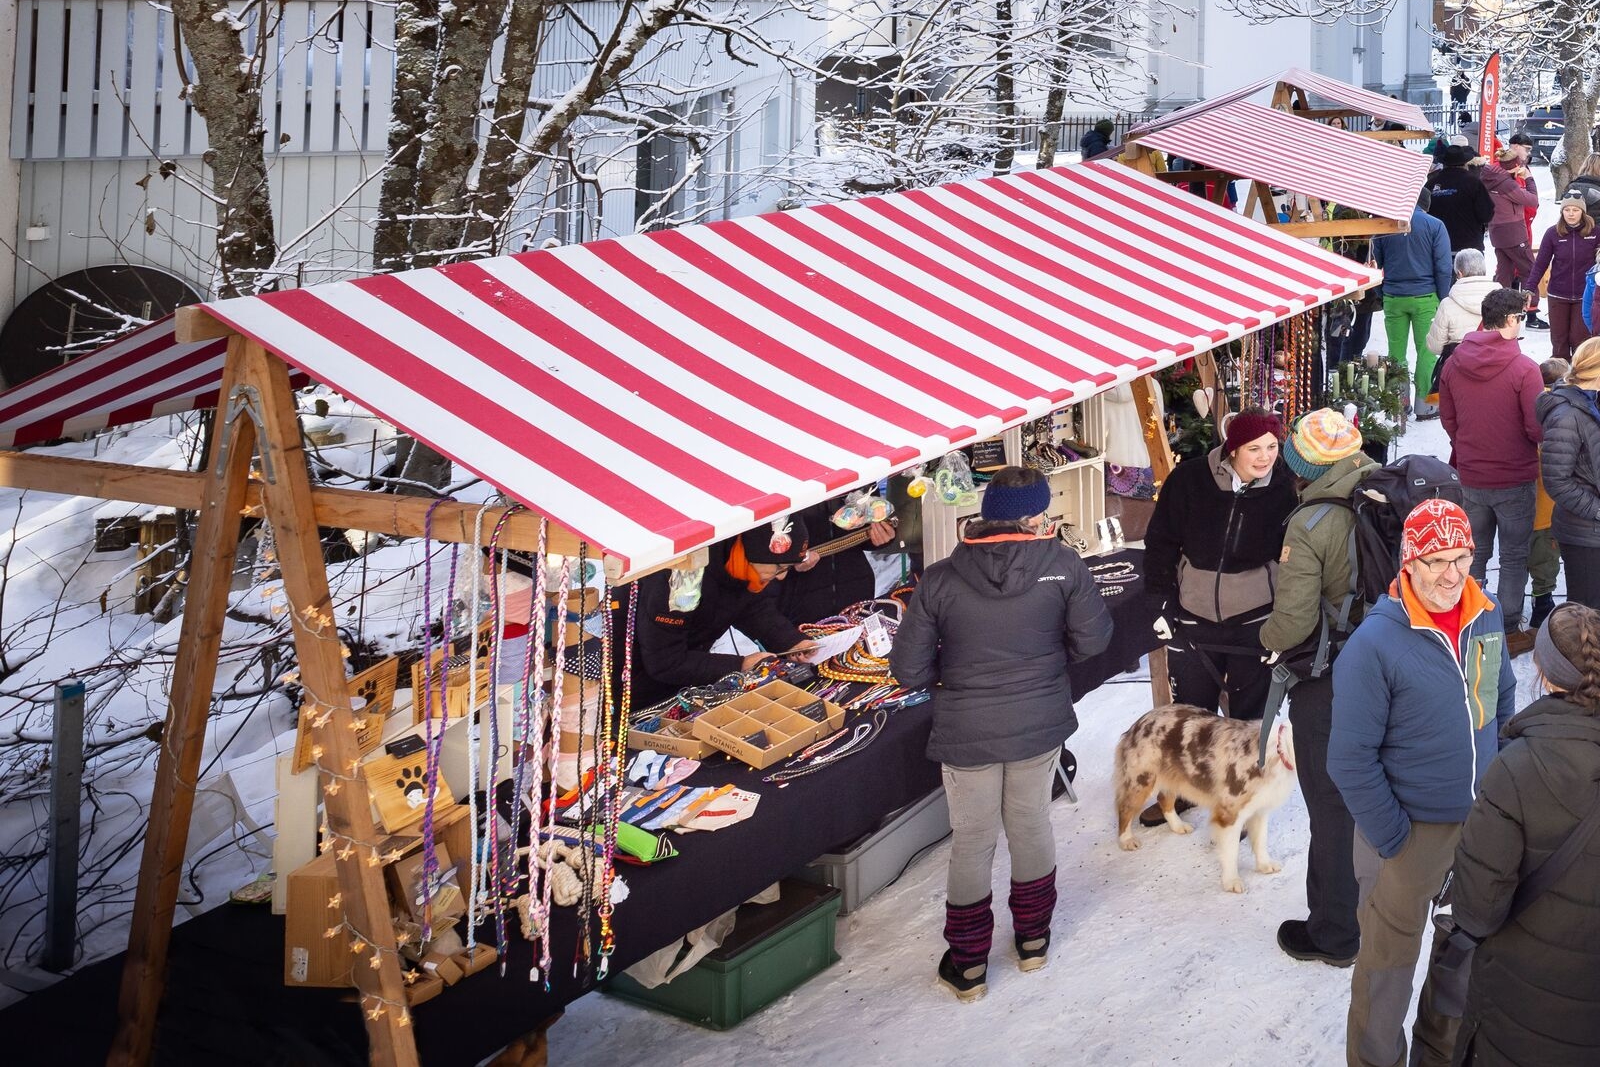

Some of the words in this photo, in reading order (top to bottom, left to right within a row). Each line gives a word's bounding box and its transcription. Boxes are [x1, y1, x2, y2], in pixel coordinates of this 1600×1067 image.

[1484, 109, 1492, 152] SCHOOL
[643, 739, 679, 752] BOTANICAL
[709, 734, 744, 757] BOTANICAL
